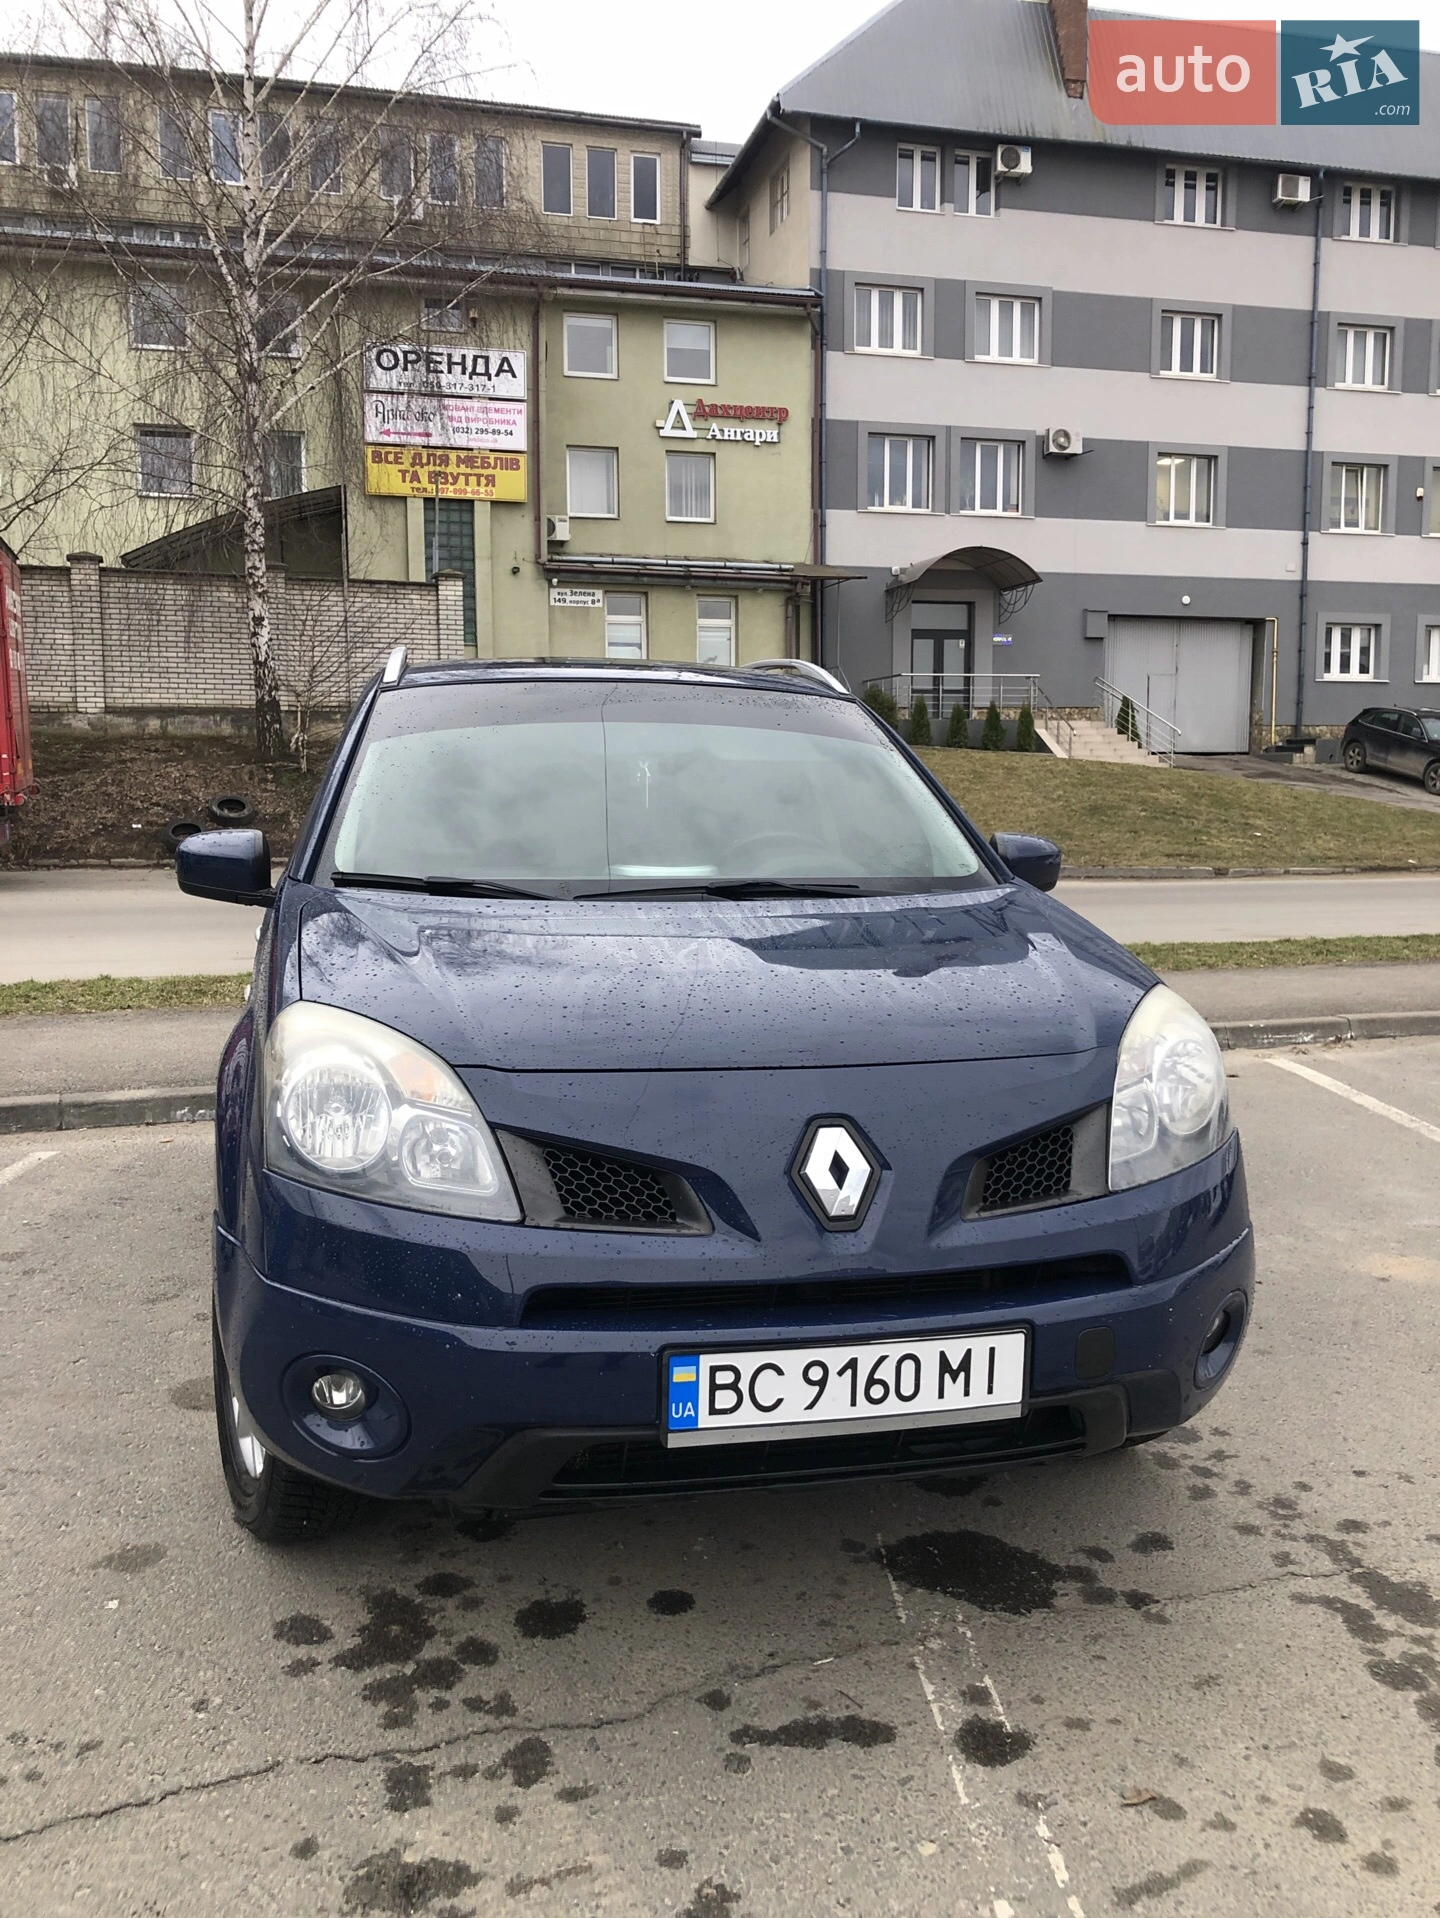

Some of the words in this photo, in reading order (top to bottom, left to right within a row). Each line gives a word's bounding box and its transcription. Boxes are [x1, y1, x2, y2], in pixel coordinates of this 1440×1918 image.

[375, 348, 518, 382] ОРЕНДА
[448, 415, 463, 424] ВІД
[465, 416, 518, 427] ВИРОБНИКА
[692, 399, 790, 424] Дахцентр
[452, 426, 473, 436] (032)
[475, 427, 514, 437] 295-89-54
[706, 423, 779, 446] Ангари
[371, 450, 405, 466] ВСЕ
[410, 452, 450, 468] ДЛЯ
[456, 454, 521, 471] МЕБЛІВ
[397, 469, 422, 485] ТА
[427, 470, 496, 488] ВЗУТТЯ
[435, 486, 494, 497] 97-899-66-55
[569, 589, 596, 598] Зелена
[671, 1402, 696, 1419] UA
[708, 1362, 786, 1416] BC
[802, 1352, 922, 1411] 9160
[938, 1346, 996, 1400] MI
